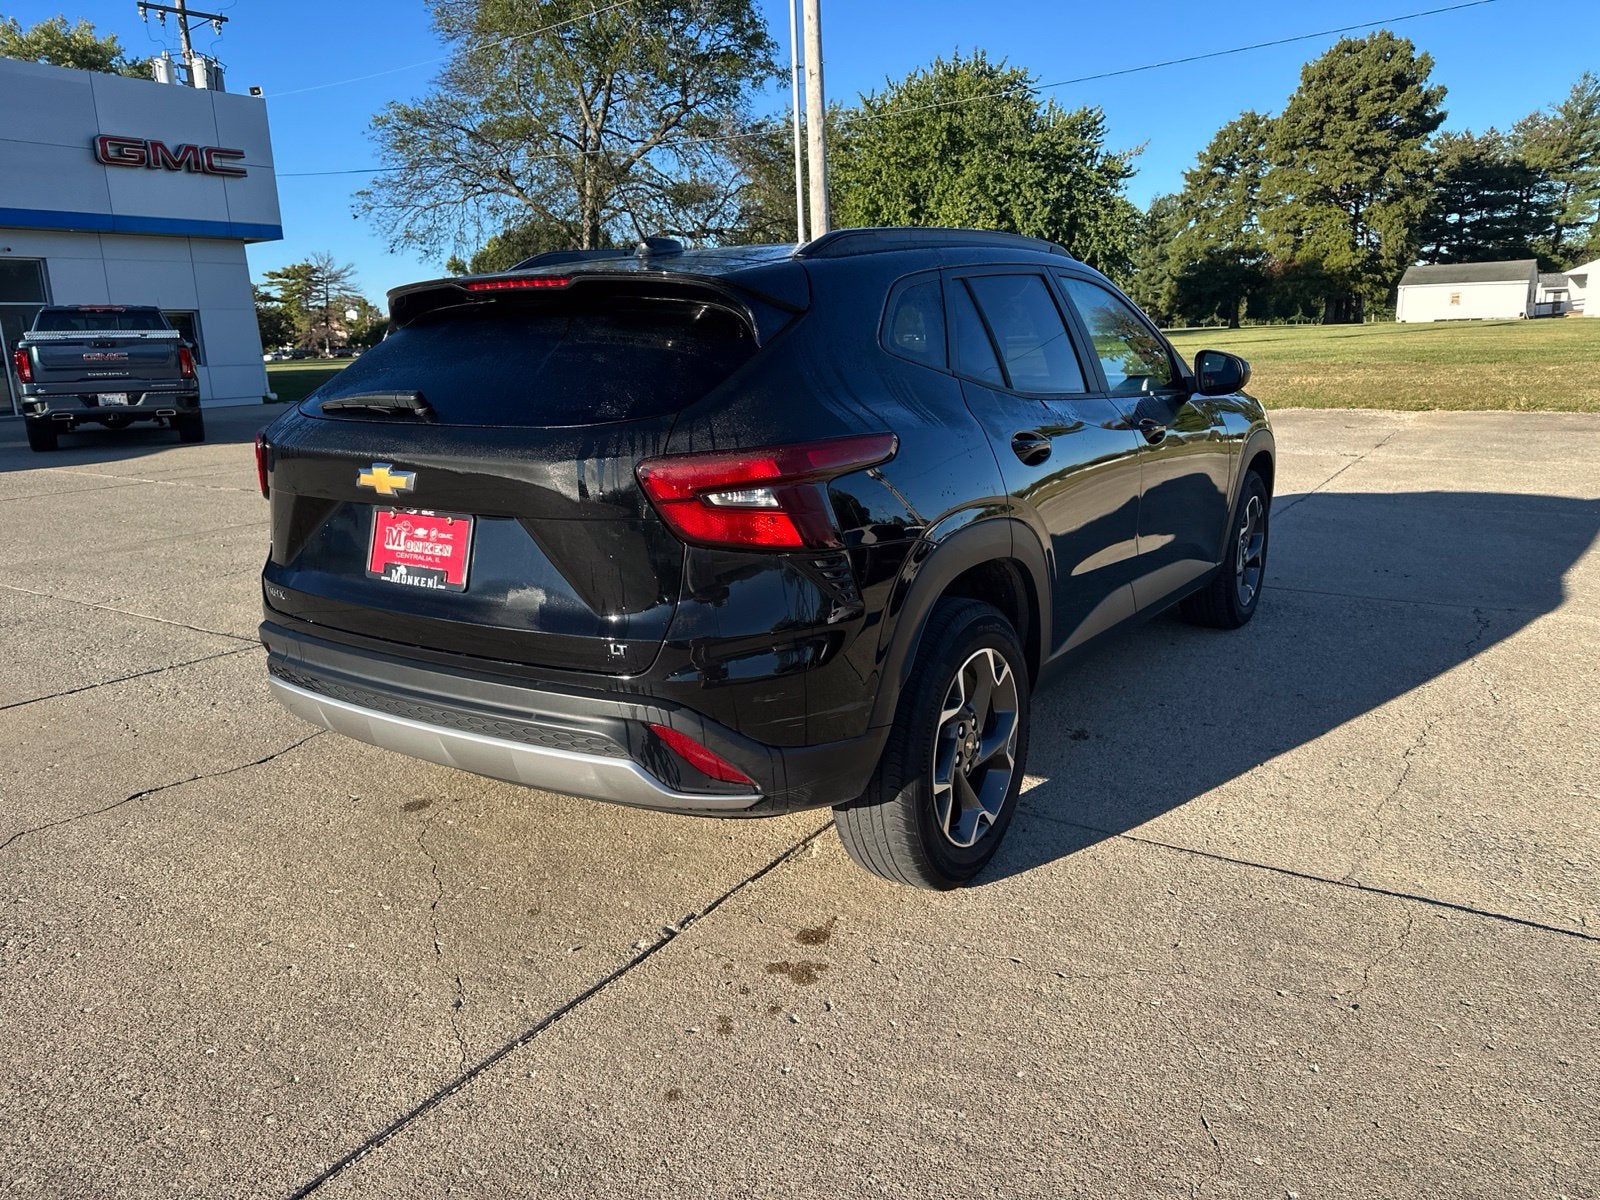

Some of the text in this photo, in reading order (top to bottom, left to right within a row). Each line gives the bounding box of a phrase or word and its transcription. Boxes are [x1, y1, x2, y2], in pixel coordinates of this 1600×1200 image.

[94, 134, 248, 177] GMC
[83, 352, 129, 361] GMC
[610, 643, 628, 656] LT
